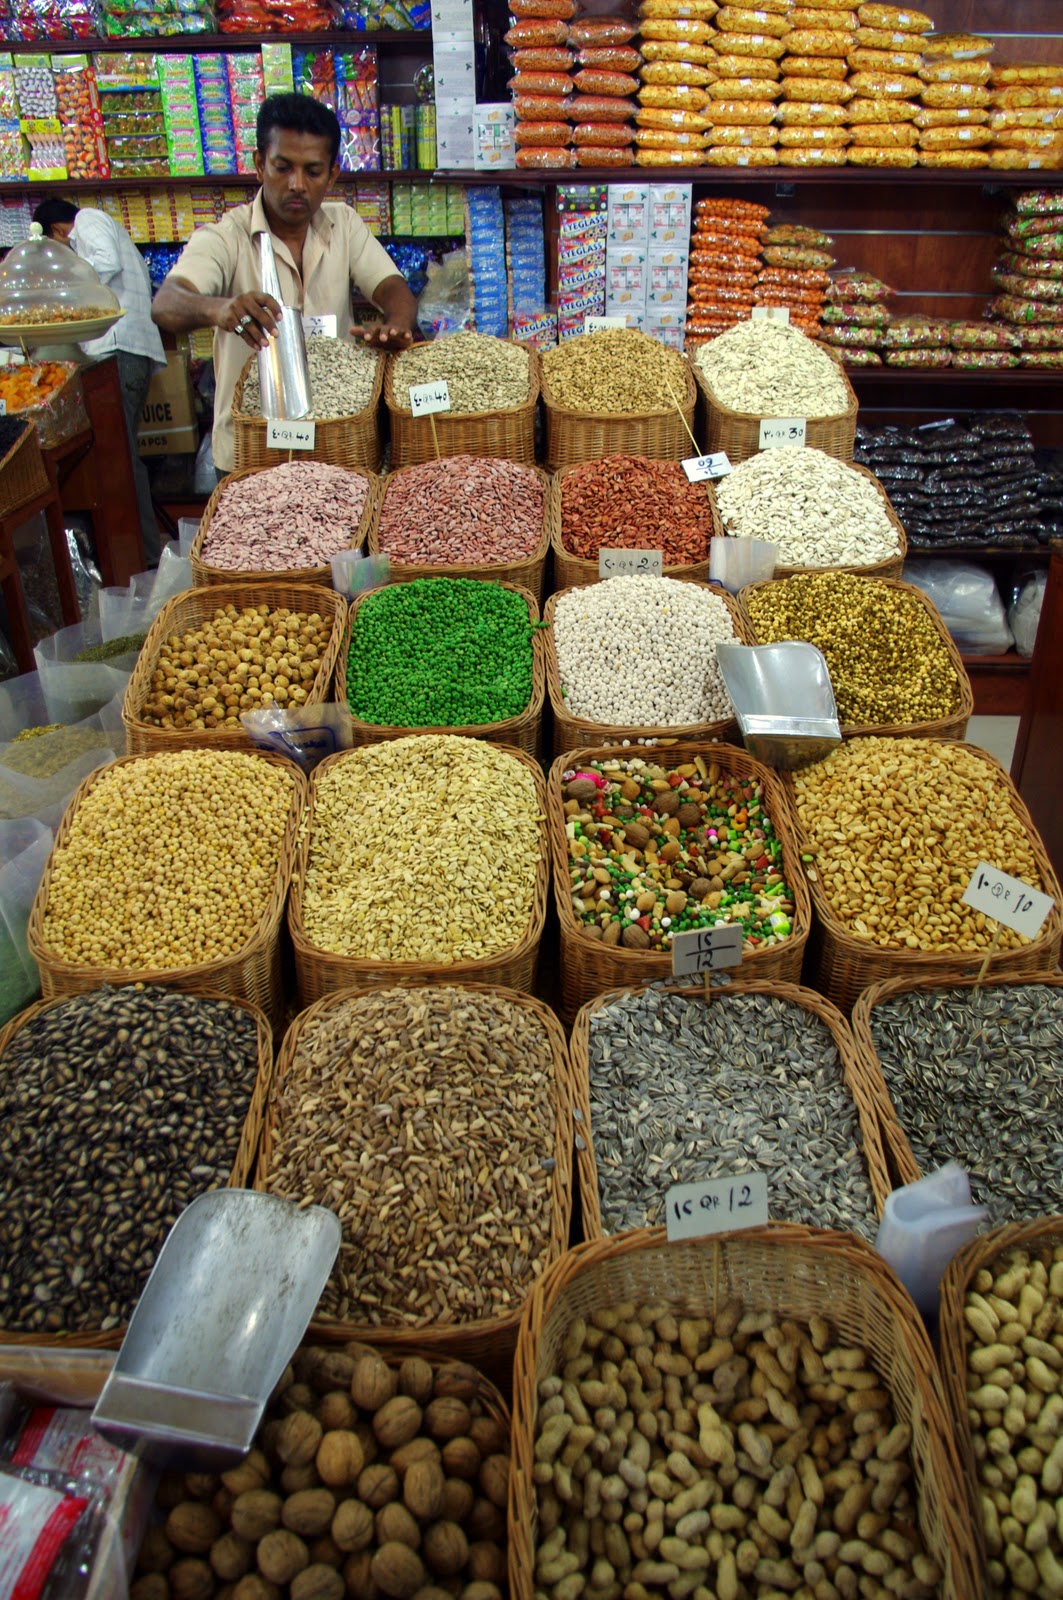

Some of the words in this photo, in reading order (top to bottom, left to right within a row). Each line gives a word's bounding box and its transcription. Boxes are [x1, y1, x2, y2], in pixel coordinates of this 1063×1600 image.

[562, 215, 604, 232] EYEGLASS
[561, 241, 602, 259] EYEGLASS
[561, 269, 602, 286] EYEGLASS
[560, 295, 602, 312] EYEGLASS
[514, 318, 555, 335] EYEGLASS
[561, 325, 585, 337] EYEG
[434, 390, 447, 404] 40
[141, 402, 173, 423] UICE
[296, 432, 309, 441] 40
[788, 427, 804, 440] 30
[637, 557, 660, 570] 20
[991, 882, 1011, 901] QR
[1012, 893, 1033, 914] 10
[696, 949, 714, 971] 12
[700, 1195, 720, 1211] QR
[729, 1185, 753, 1213] 12
